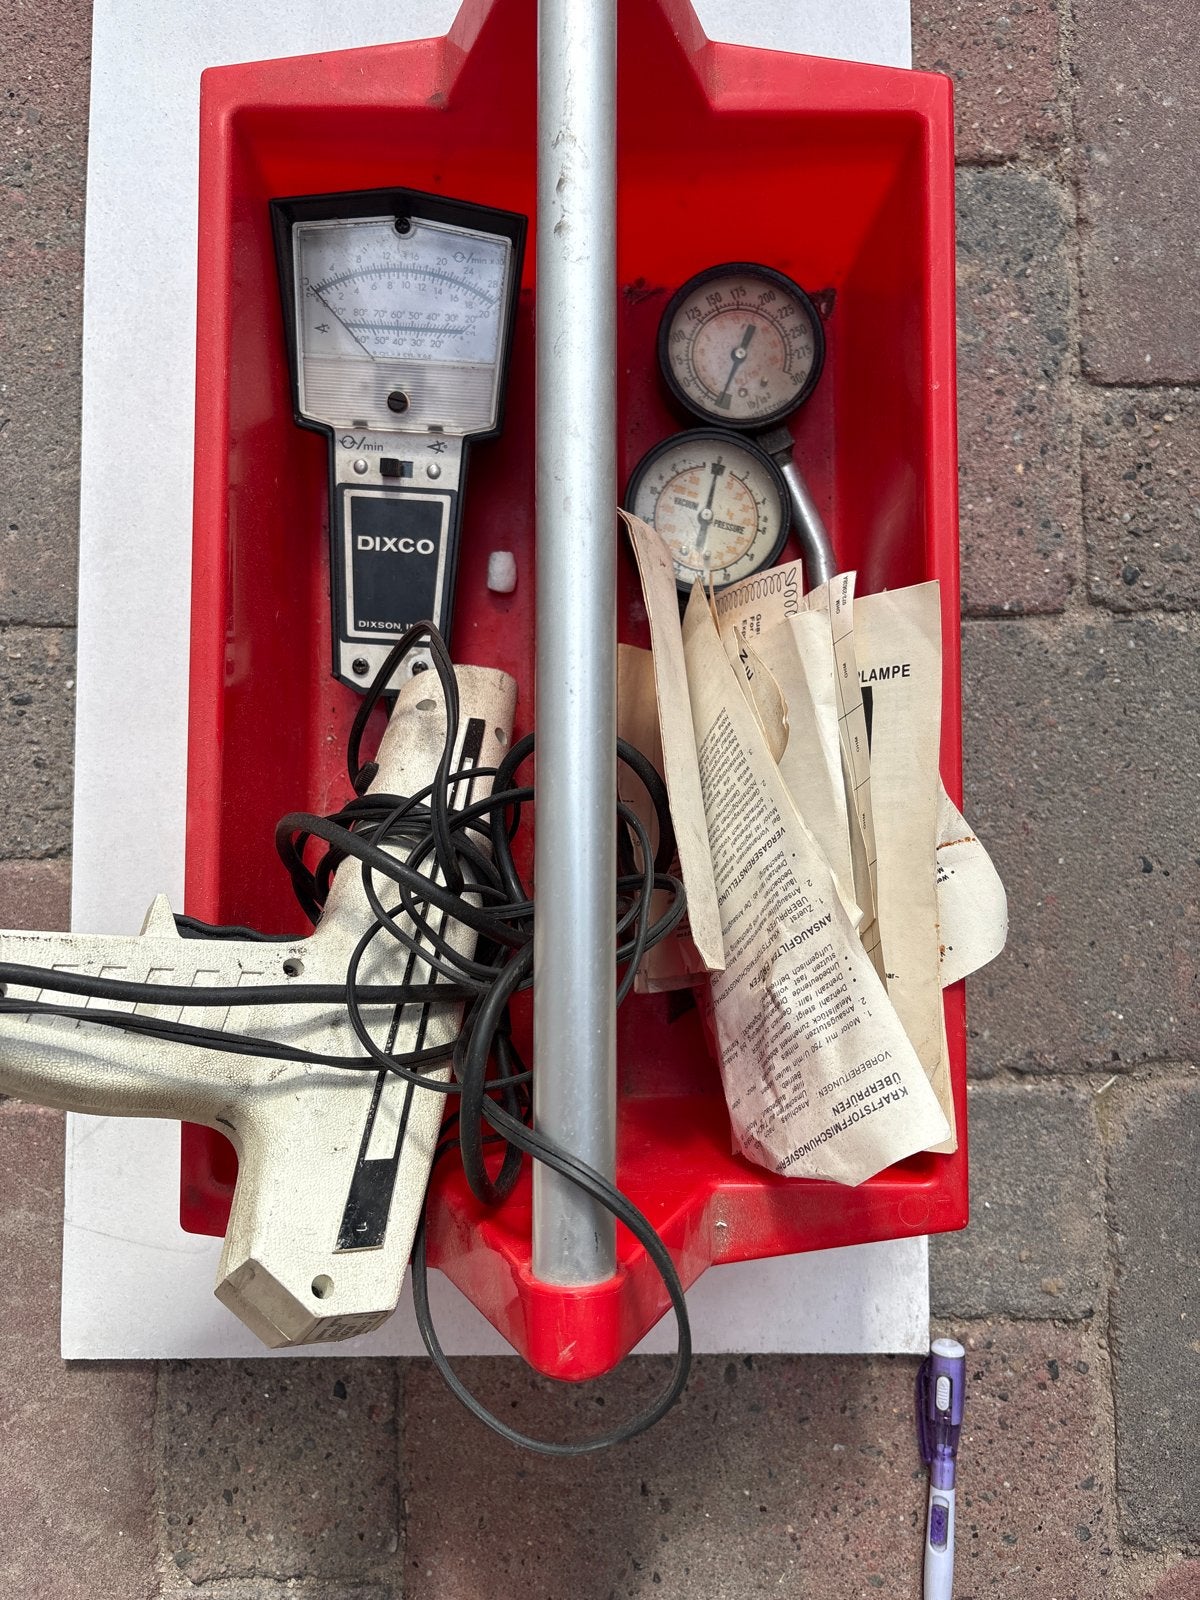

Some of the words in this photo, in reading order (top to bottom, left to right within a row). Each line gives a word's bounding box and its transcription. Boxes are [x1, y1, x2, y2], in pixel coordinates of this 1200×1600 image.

[356, 254, 362, 264] 8
[382, 252, 391, 260] 12
[411, 252, 419, 262] 16
[436, 257, 448, 266] 20
[463, 266, 474, 276] 24
[338, 292, 344, 300] 2
[371, 282, 377, 290] 6
[387, 281, 393, 289] 8
[402, 281, 411, 289] 10
[418, 282, 427, 291] 12
[434, 286, 442, 295] 14
[450, 294, 459, 302] 16
[479, 310, 490, 319] 20
[705, 292, 722, 307] 150
[730, 286, 747, 300] 175
[758, 290, 776, 306] 200
[684, 306, 702, 322] 125
[777, 304, 795, 319] 225
[789, 325, 808, 339] 250
[795, 345, 812, 360] 275
[790, 370, 806, 386] 300
[714, 519, 746, 535] PRESSURE
[357, 535, 435, 555] DIXCO
[358, 620, 402, 632] DIXSON,
[858, 663, 911, 683] LAMPE
[735, 764, 751, 782] weise
[741, 796, 764, 822] schraube
[761, 805, 779, 824] Motor
[730, 821, 743, 836] nach
[752, 822, 762, 833] ist
[770, 813, 782, 826] Bei
[764, 858, 788, 882] Drehzahl
[741, 899, 753, 912] Der
[788, 902, 814, 924] Zuerst
[790, 942, 833, 975] Luftgemisch
[810, 951, 837, 973] stutzen
[790, 960, 840, 998] Unbedeutende
[792, 972, 808, 986] fast
[812, 971, 844, 998] Drehzahl
[816, 982, 848, 1008] Drehzahl
[769, 1006, 793, 1029] Gemisch
[791, 1003, 817, 1023] steigt:
[811, 994, 852, 1024] Metallstück
[803, 1003, 856, 1040] Ansaugstutzen
[838, 1016, 861, 1033] Motor
[768, 1020, 792, 1044] Gemisch
[823, 1030, 839, 1043] mit
[780, 1041, 800, 1062] mittels
[808, 1040, 823, 1053] 750
[773, 1064, 793, 1082] laufen
[779, 1070, 802, 1089] Betrieb.
[815, 1050, 891, 1099] VORBEREITUNGEN:
[830, 1071, 902, 1116] ÜBERPRÜFEN
